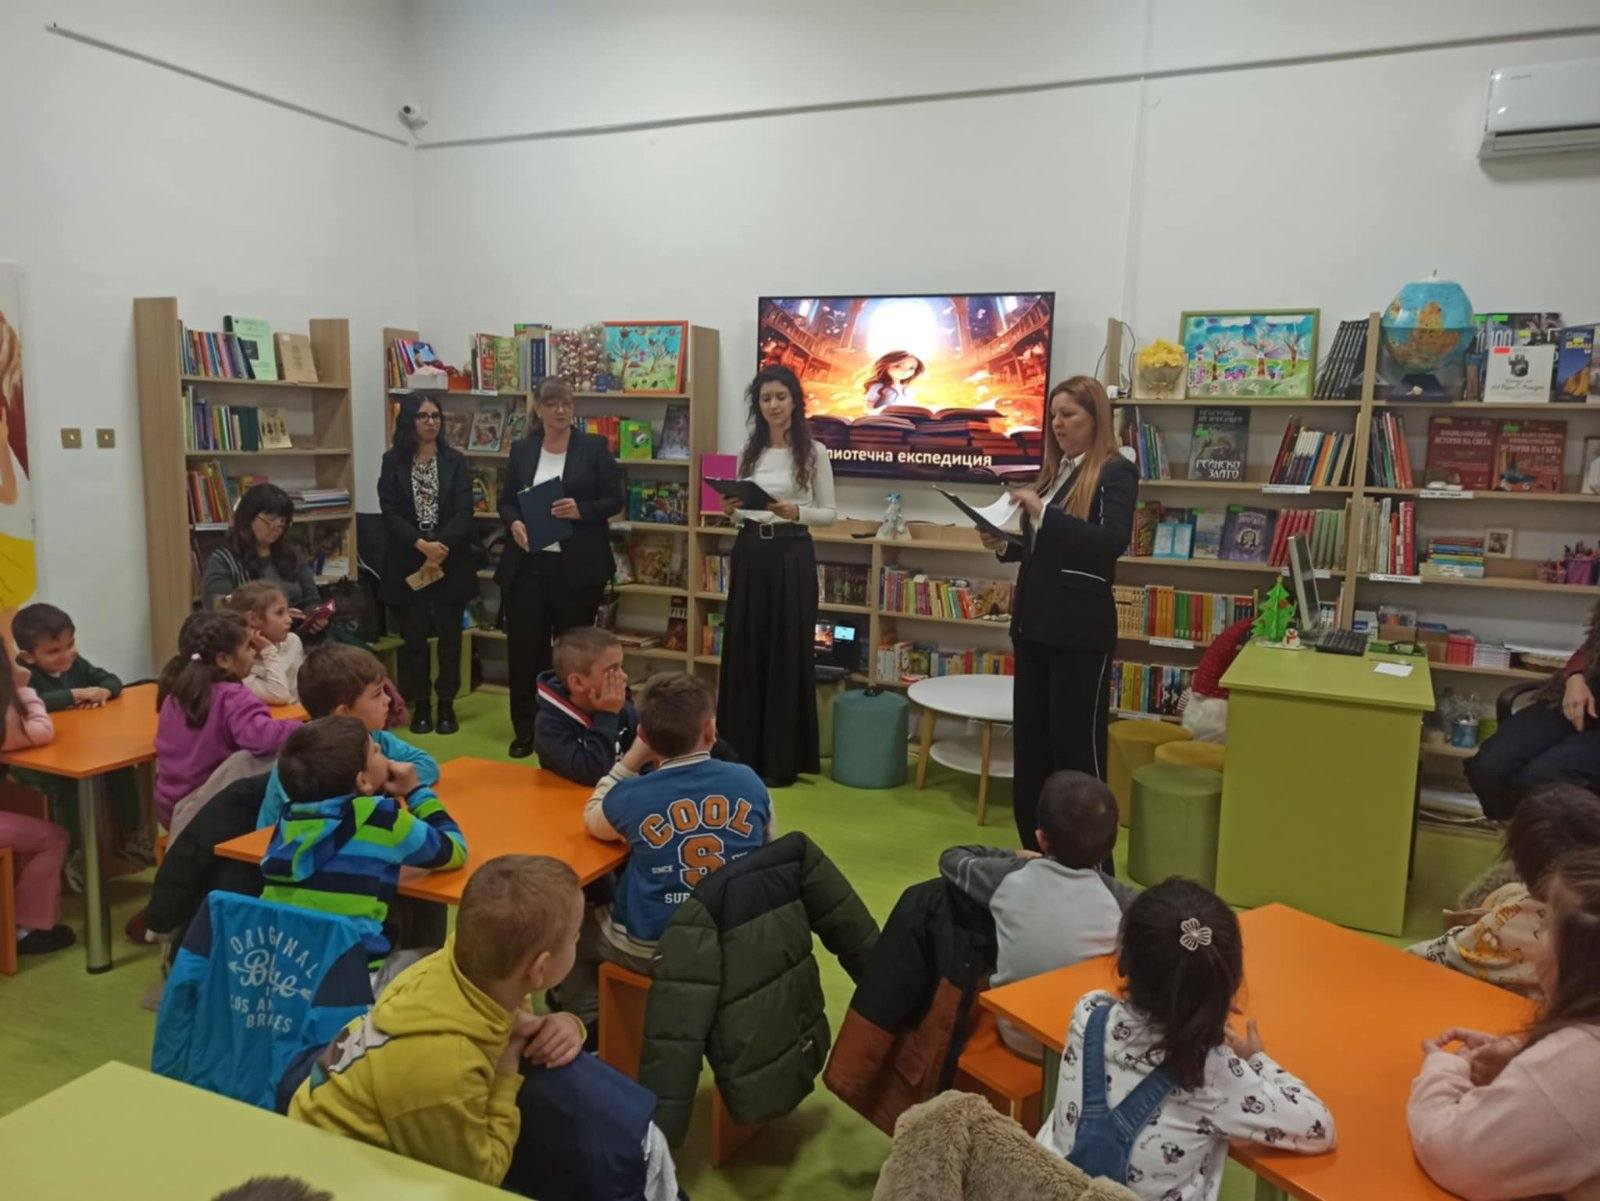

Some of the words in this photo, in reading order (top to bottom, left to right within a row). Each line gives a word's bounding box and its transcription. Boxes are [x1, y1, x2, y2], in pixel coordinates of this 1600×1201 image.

[898, 452, 992, 467] експедиция
[639, 795, 753, 849] COOL
[230, 925, 319, 979] ORIGINAL
